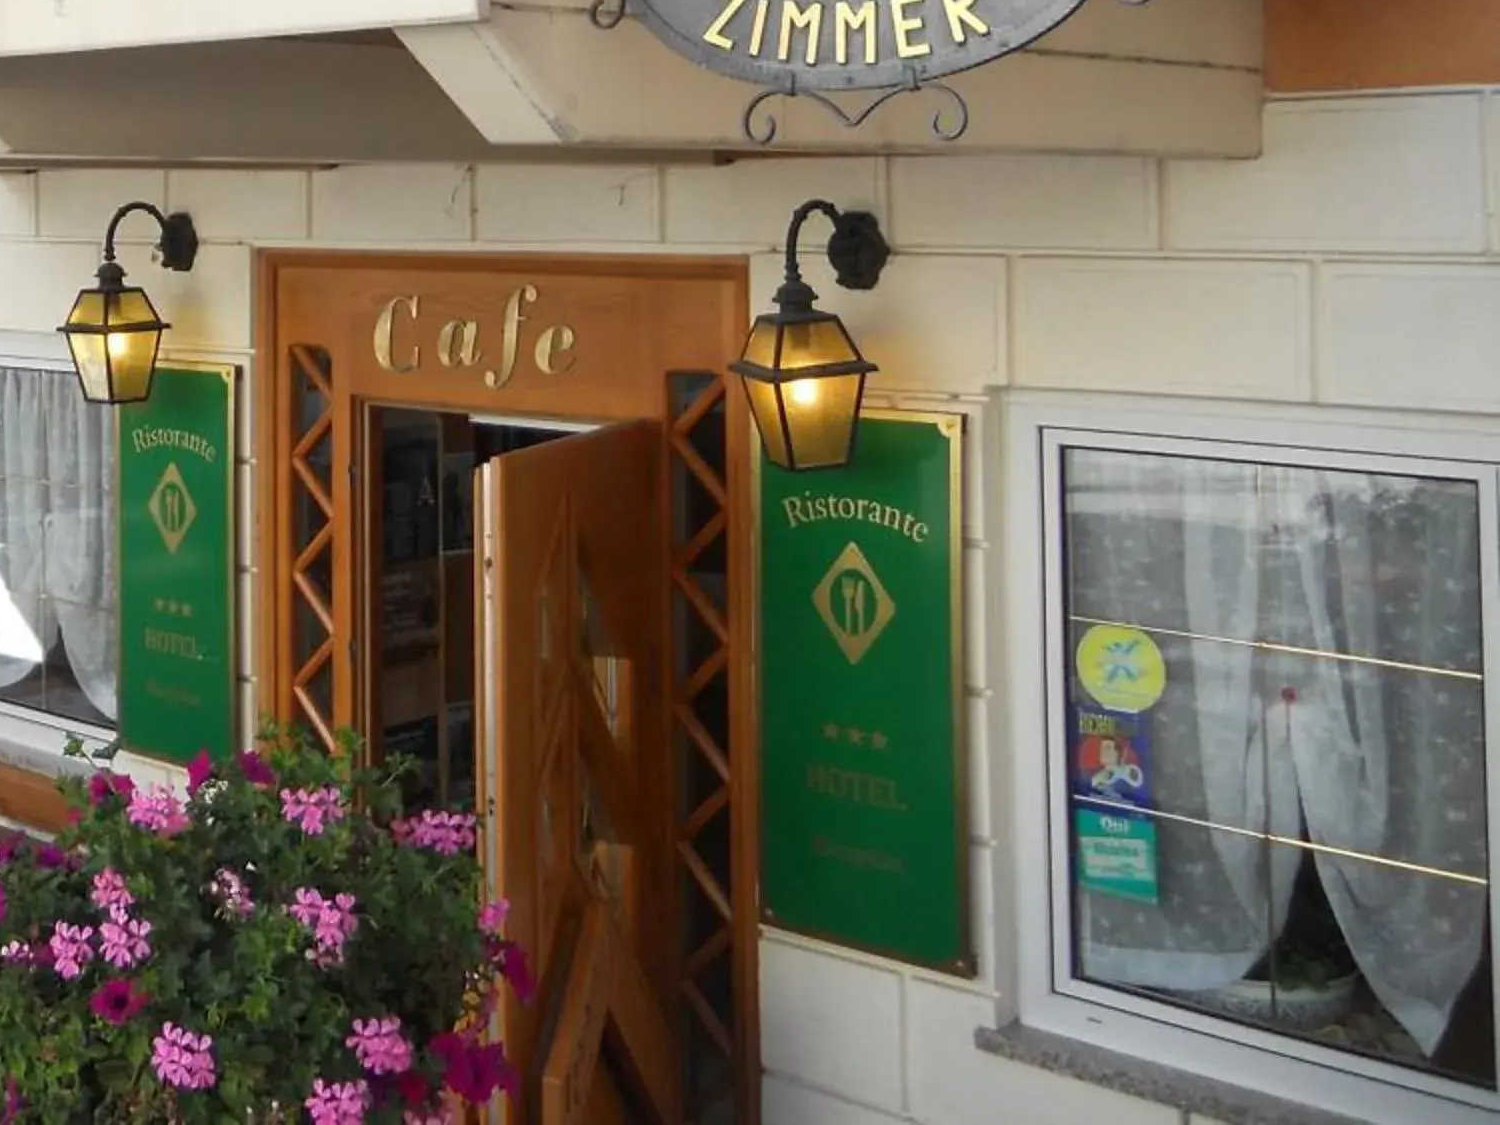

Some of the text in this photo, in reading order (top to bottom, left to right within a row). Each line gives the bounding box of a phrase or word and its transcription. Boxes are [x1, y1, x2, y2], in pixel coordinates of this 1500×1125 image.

[373, 283, 578, 389] Cafe
[131, 424, 216, 463] Ristorante
[782, 491, 929, 544] Ristorante
[144, 626, 203, 661] HOTEL
[806, 763, 908, 812] HOTEL
